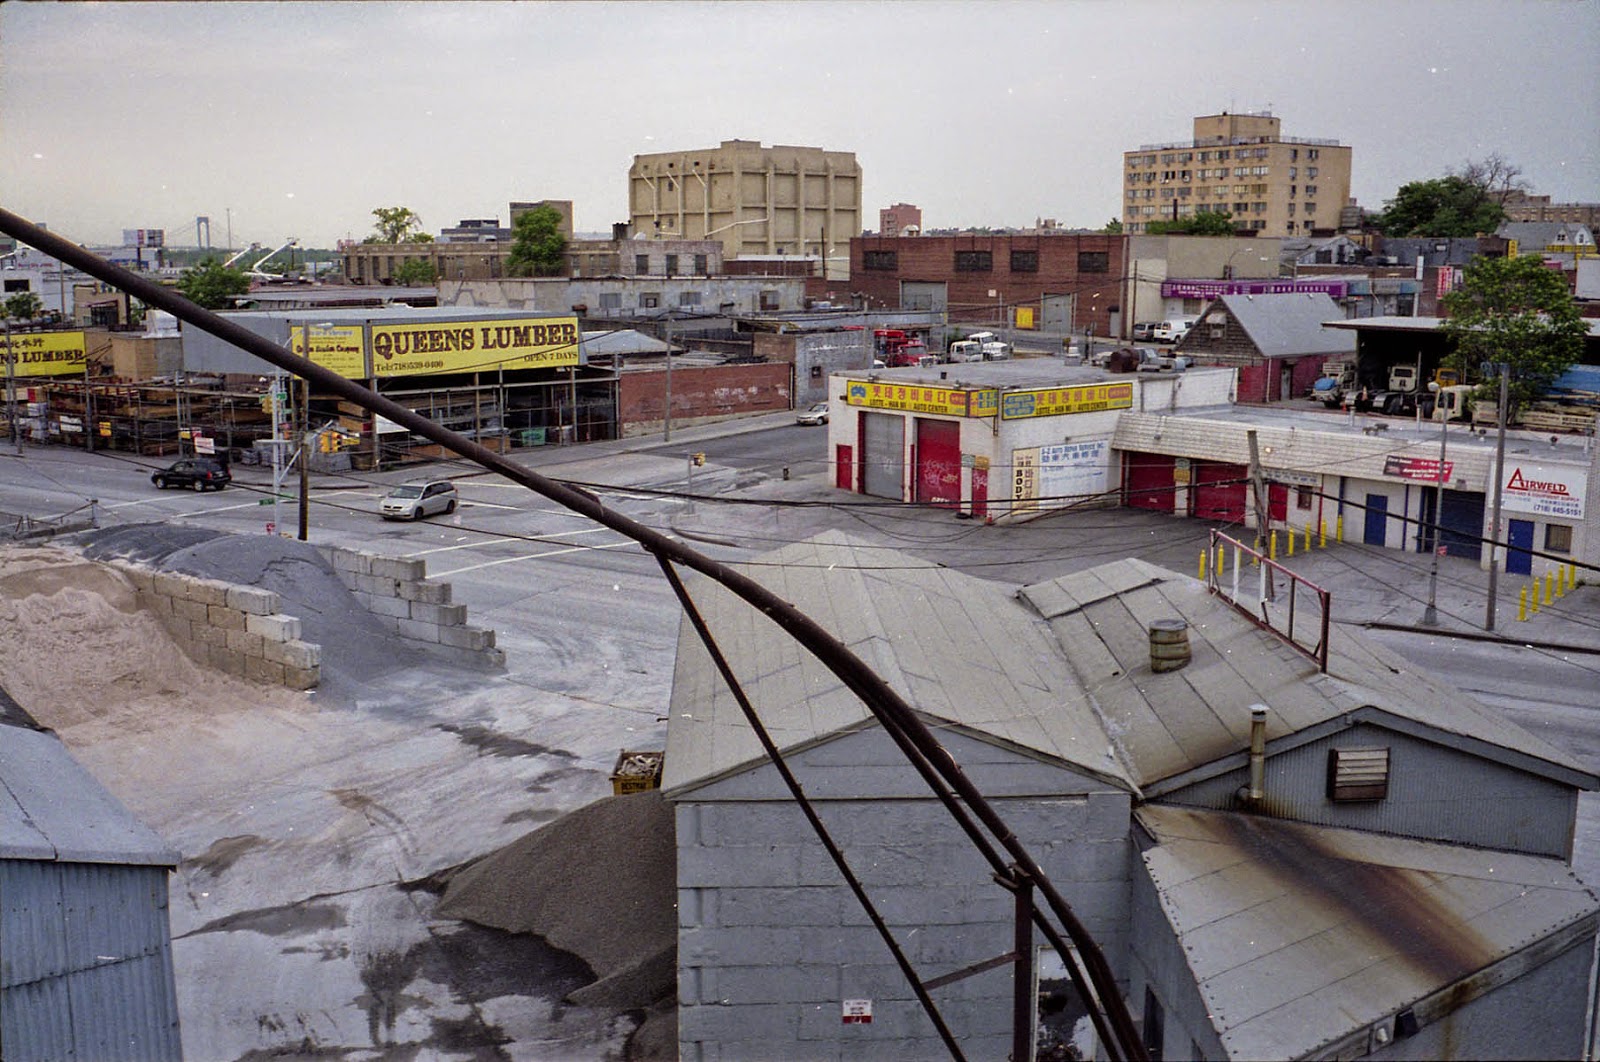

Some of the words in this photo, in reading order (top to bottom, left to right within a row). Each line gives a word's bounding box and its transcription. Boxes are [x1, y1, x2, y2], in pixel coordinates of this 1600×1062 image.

[374, 328, 475, 360] QUEENS
[481, 324, 577, 349] LUMBER
[22, 349, 83, 363] LUMBER
[523, 353, 547, 362] OPEN
[556, 352, 577, 360] DAYS
[869, 399, 884, 407] LOTTE
[913, 403, 927, 411] AUTO
[928, 405, 948, 413] CENTER
